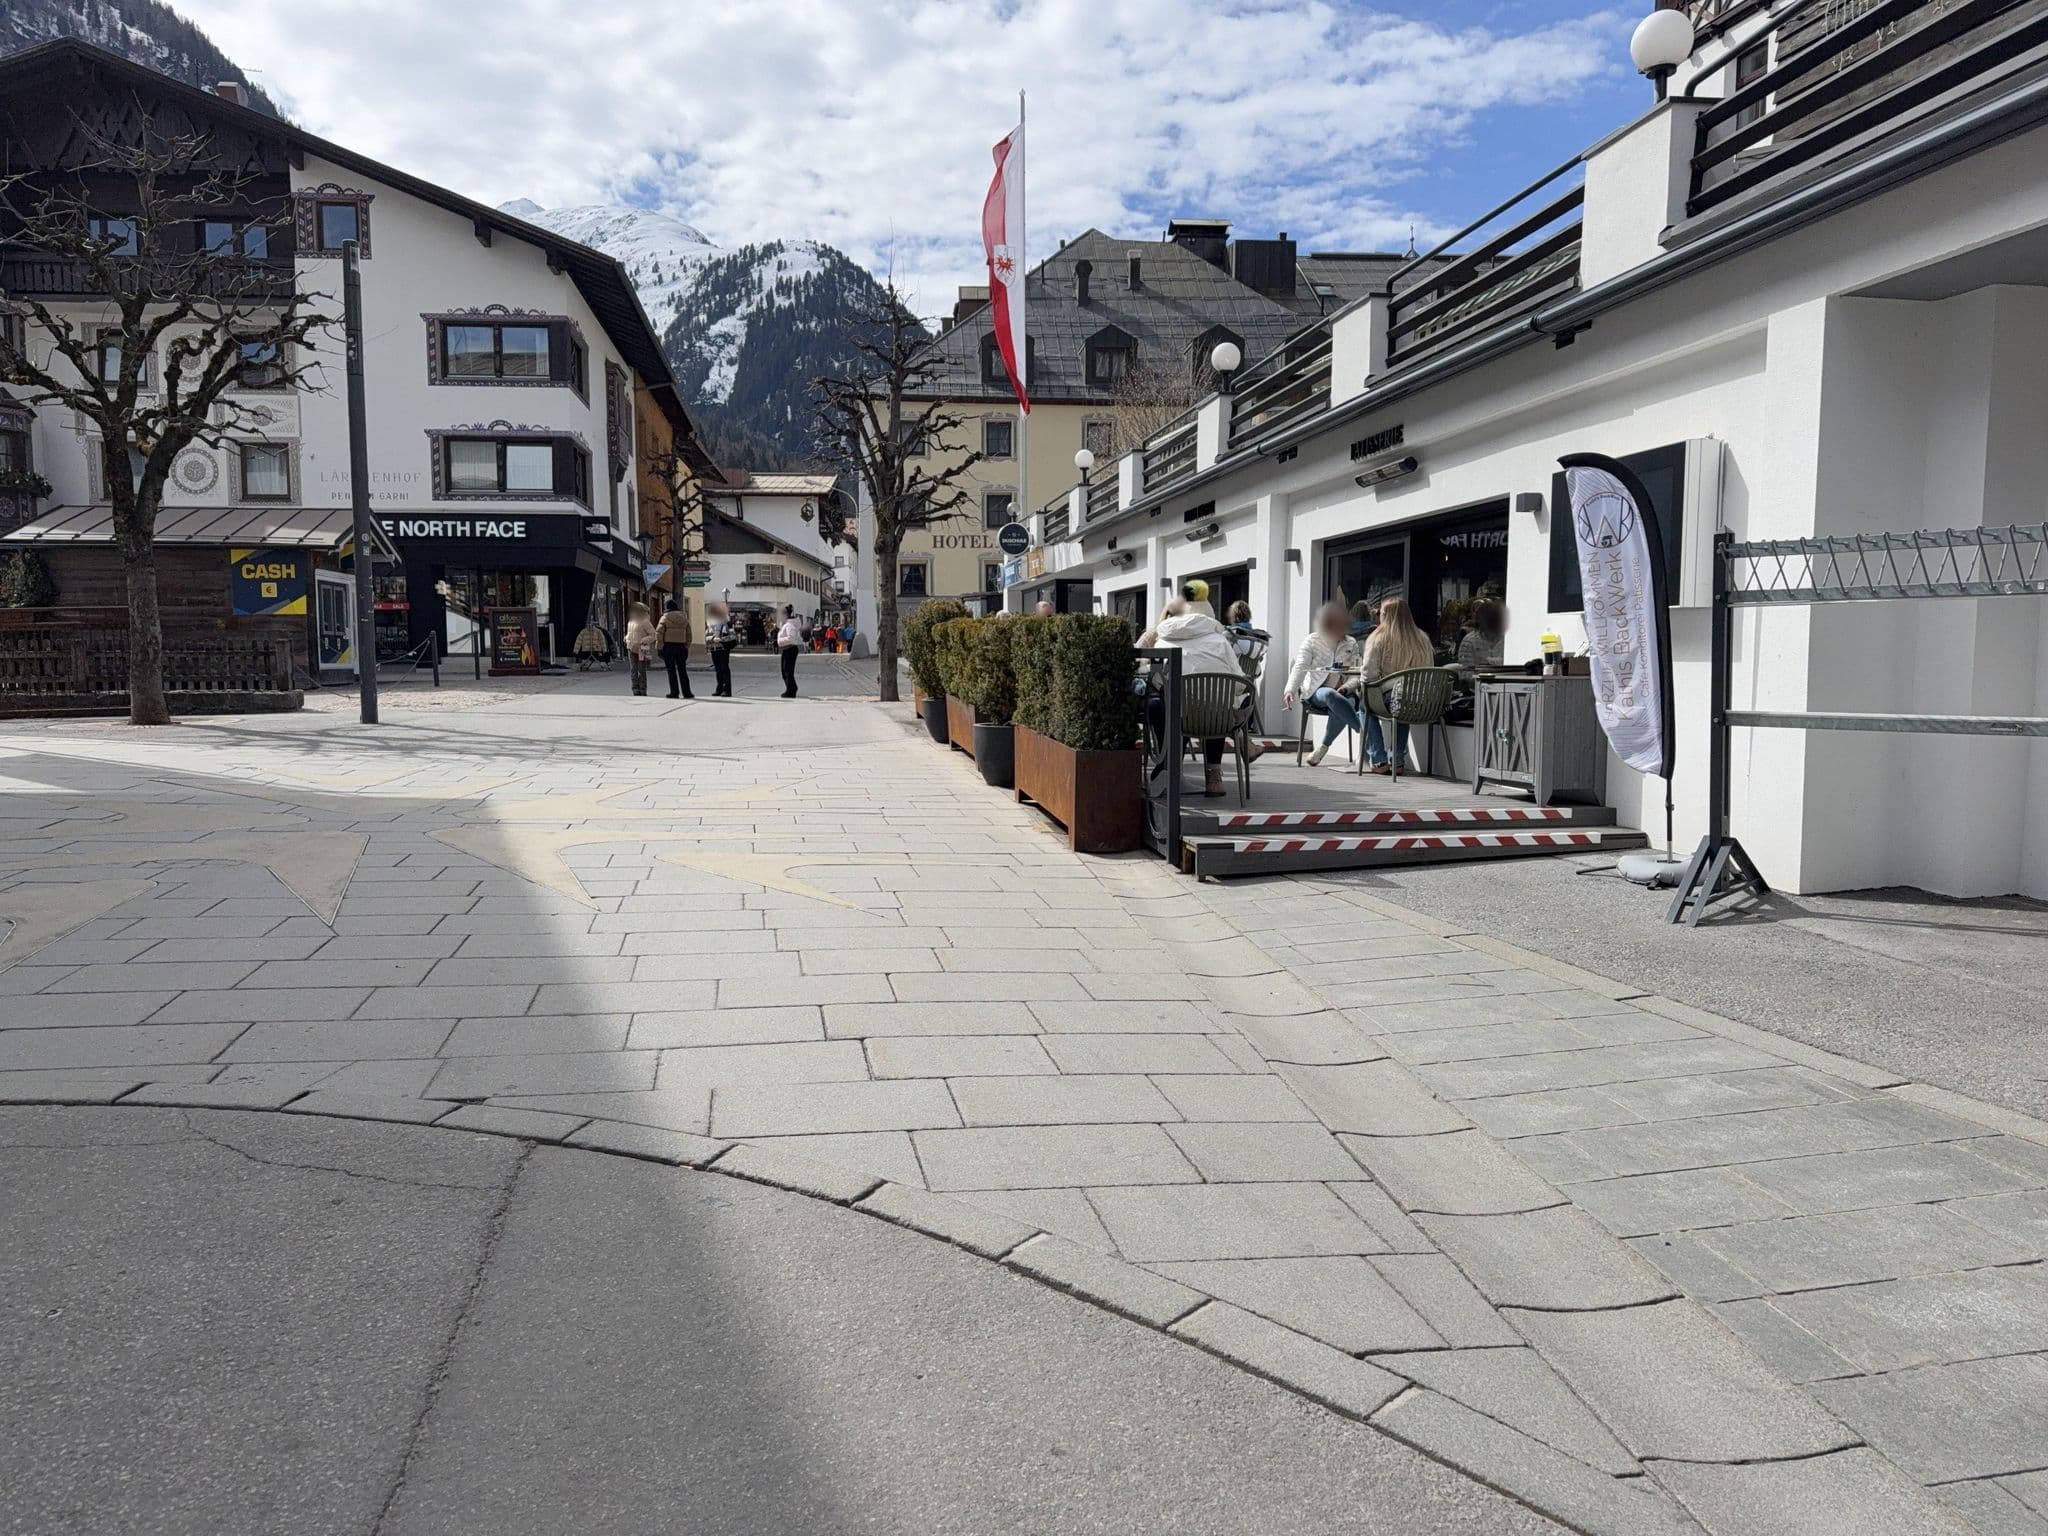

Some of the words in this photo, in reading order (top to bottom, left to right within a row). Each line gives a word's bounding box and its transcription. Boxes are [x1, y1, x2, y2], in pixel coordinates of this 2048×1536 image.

[320, 470, 421, 482] LÄRENHOF
[379, 492, 409, 500] GARNI
[399, 520, 471, 538] NORTH
[475, 521, 526, 538] FACE
[932, 534, 993, 549] HOTEL
[241, 563, 296, 579] CASH
[1587, 551, 1609, 657] WILLKOMMEN
[1604, 551, 1631, 655] BackWerk
[1615, 661, 1635, 720] Kathis
